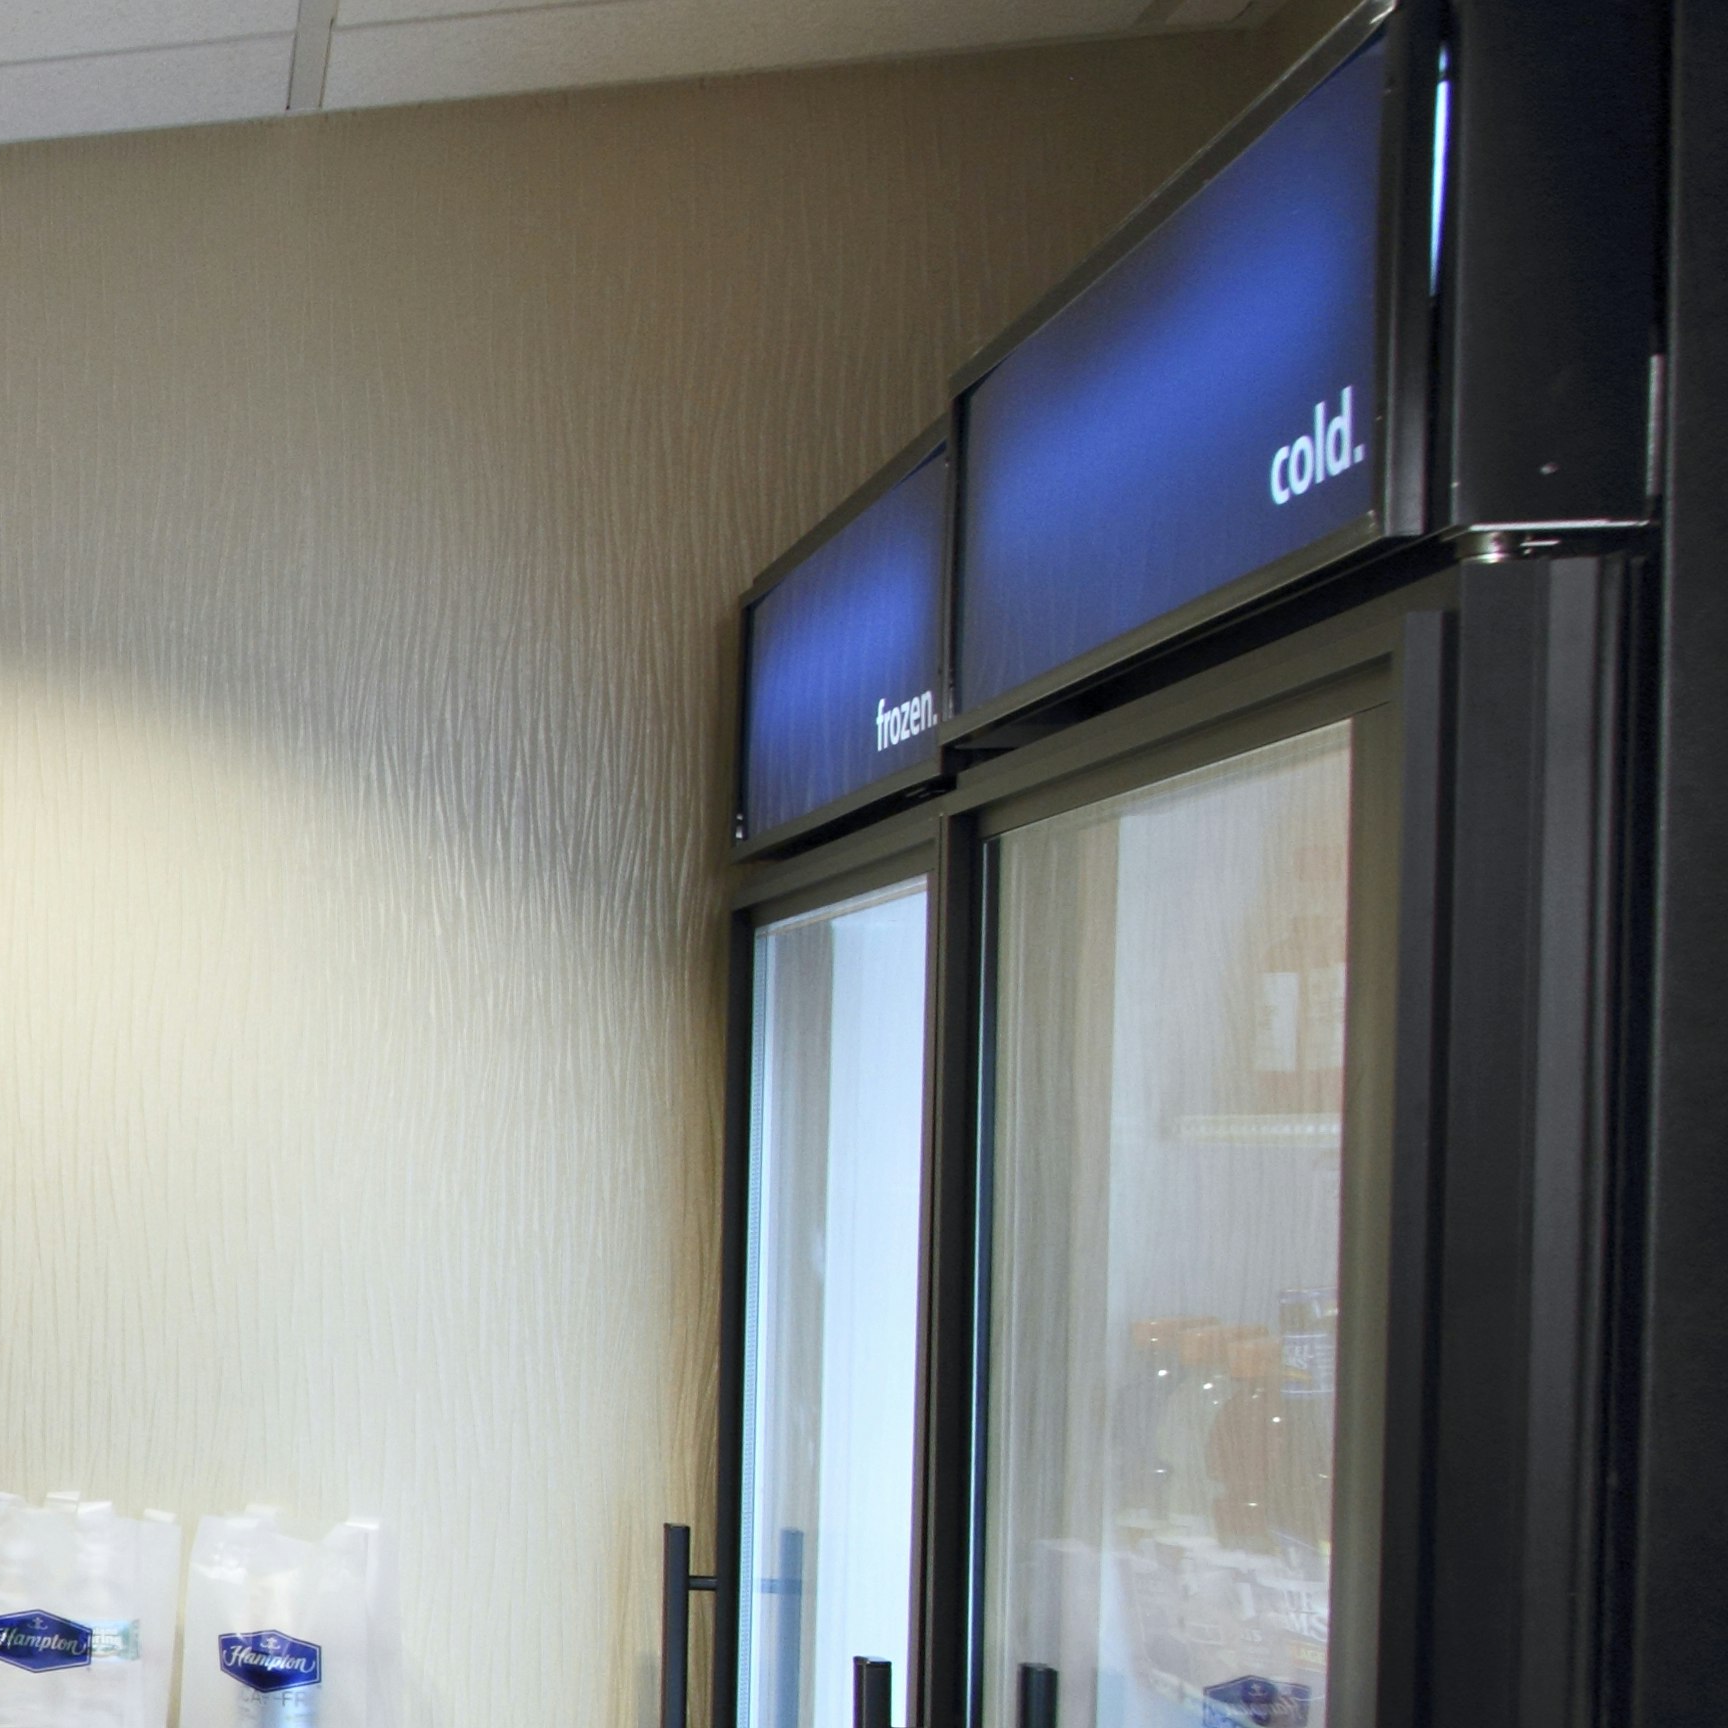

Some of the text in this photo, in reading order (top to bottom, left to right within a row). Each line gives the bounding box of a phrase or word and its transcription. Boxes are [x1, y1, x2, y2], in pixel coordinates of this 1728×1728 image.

[1271, 386, 1364, 505] cold.
[876, 689, 938, 752] frozen.
[223, 1644, 316, 1674] Hampton
